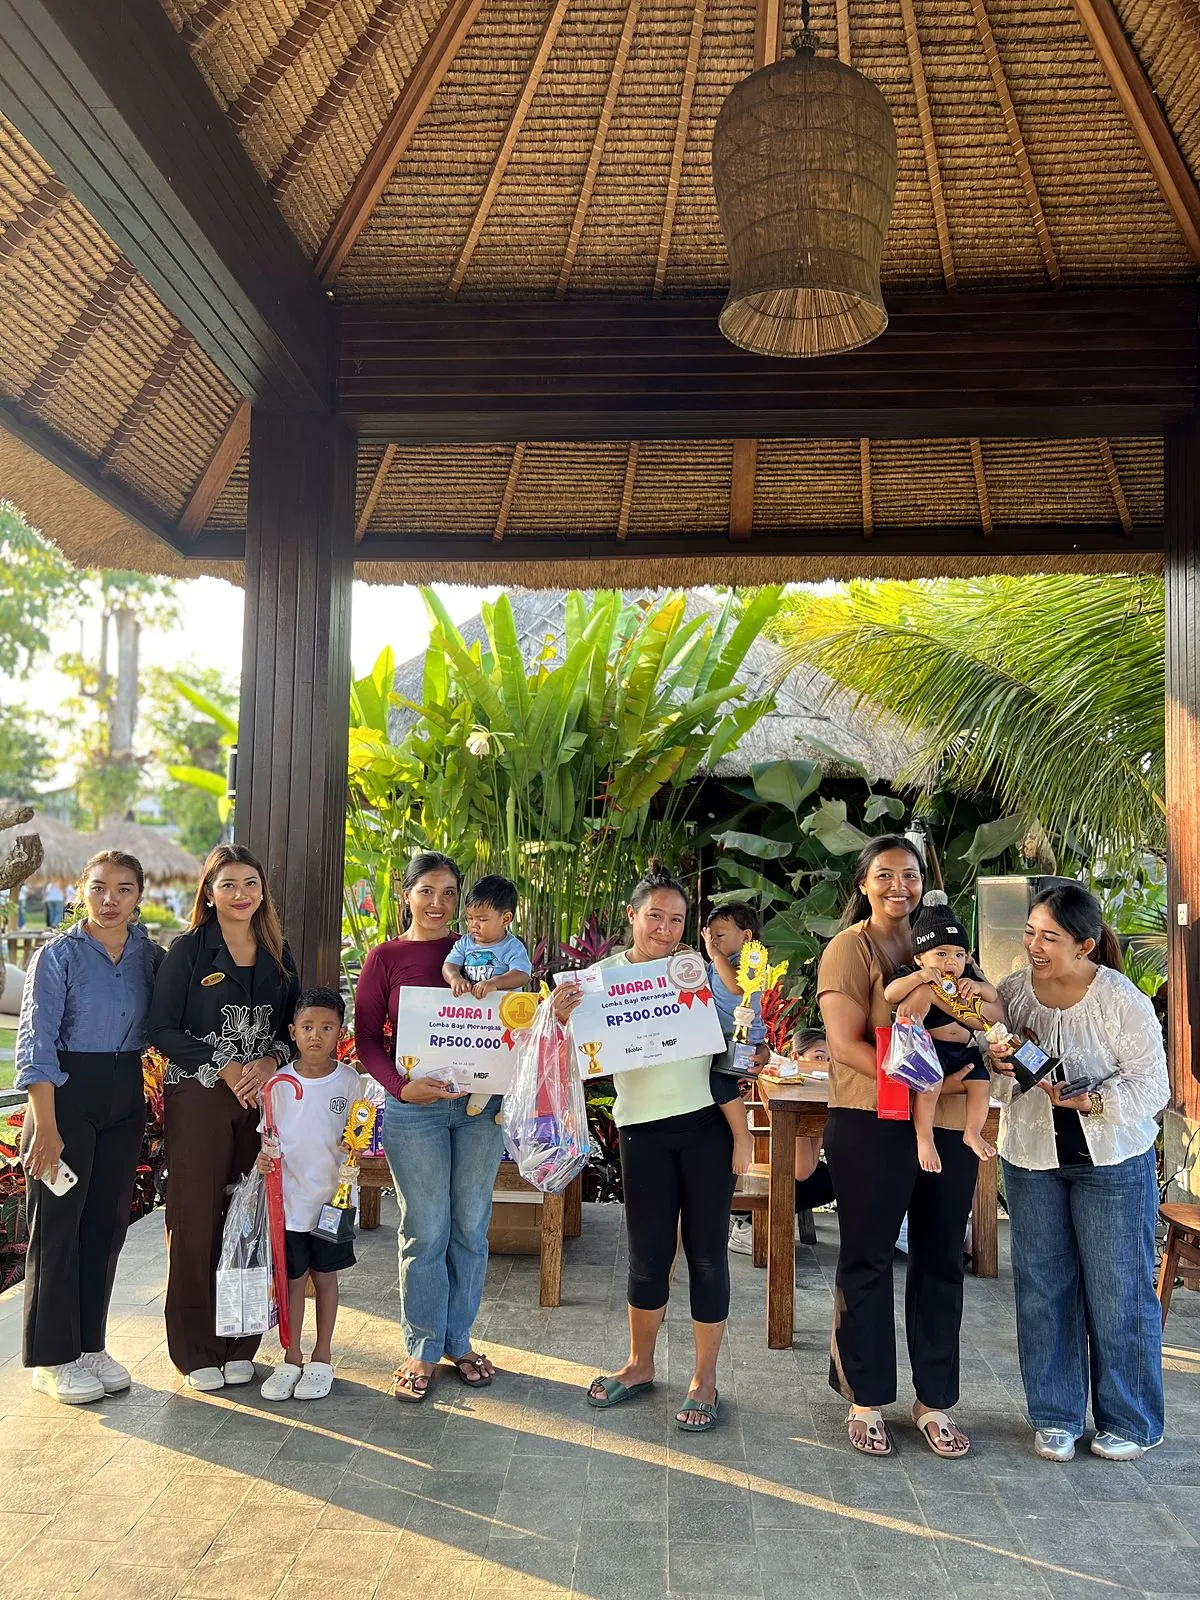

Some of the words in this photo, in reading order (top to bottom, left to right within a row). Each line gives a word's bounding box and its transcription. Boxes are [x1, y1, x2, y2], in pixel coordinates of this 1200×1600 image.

[681, 962, 697, 979] 2
[608, 980, 654, 997] JUARA
[657, 976, 668, 988] II
[602, 1000, 622, 1008] Lomba
[624, 997, 638, 1005] Bayi
[640, 990, 676, 1003] Merangkak
[438, 1006, 482, 1020] JUARA
[606, 1004, 680, 1027] Rp300.000
[452, 1022, 466, 1030] Bayi
[430, 1035, 502, 1050] Rp500.000
[662, 1038, 678, 1048] MBF
[332, 1100, 346, 1112] DEUS
